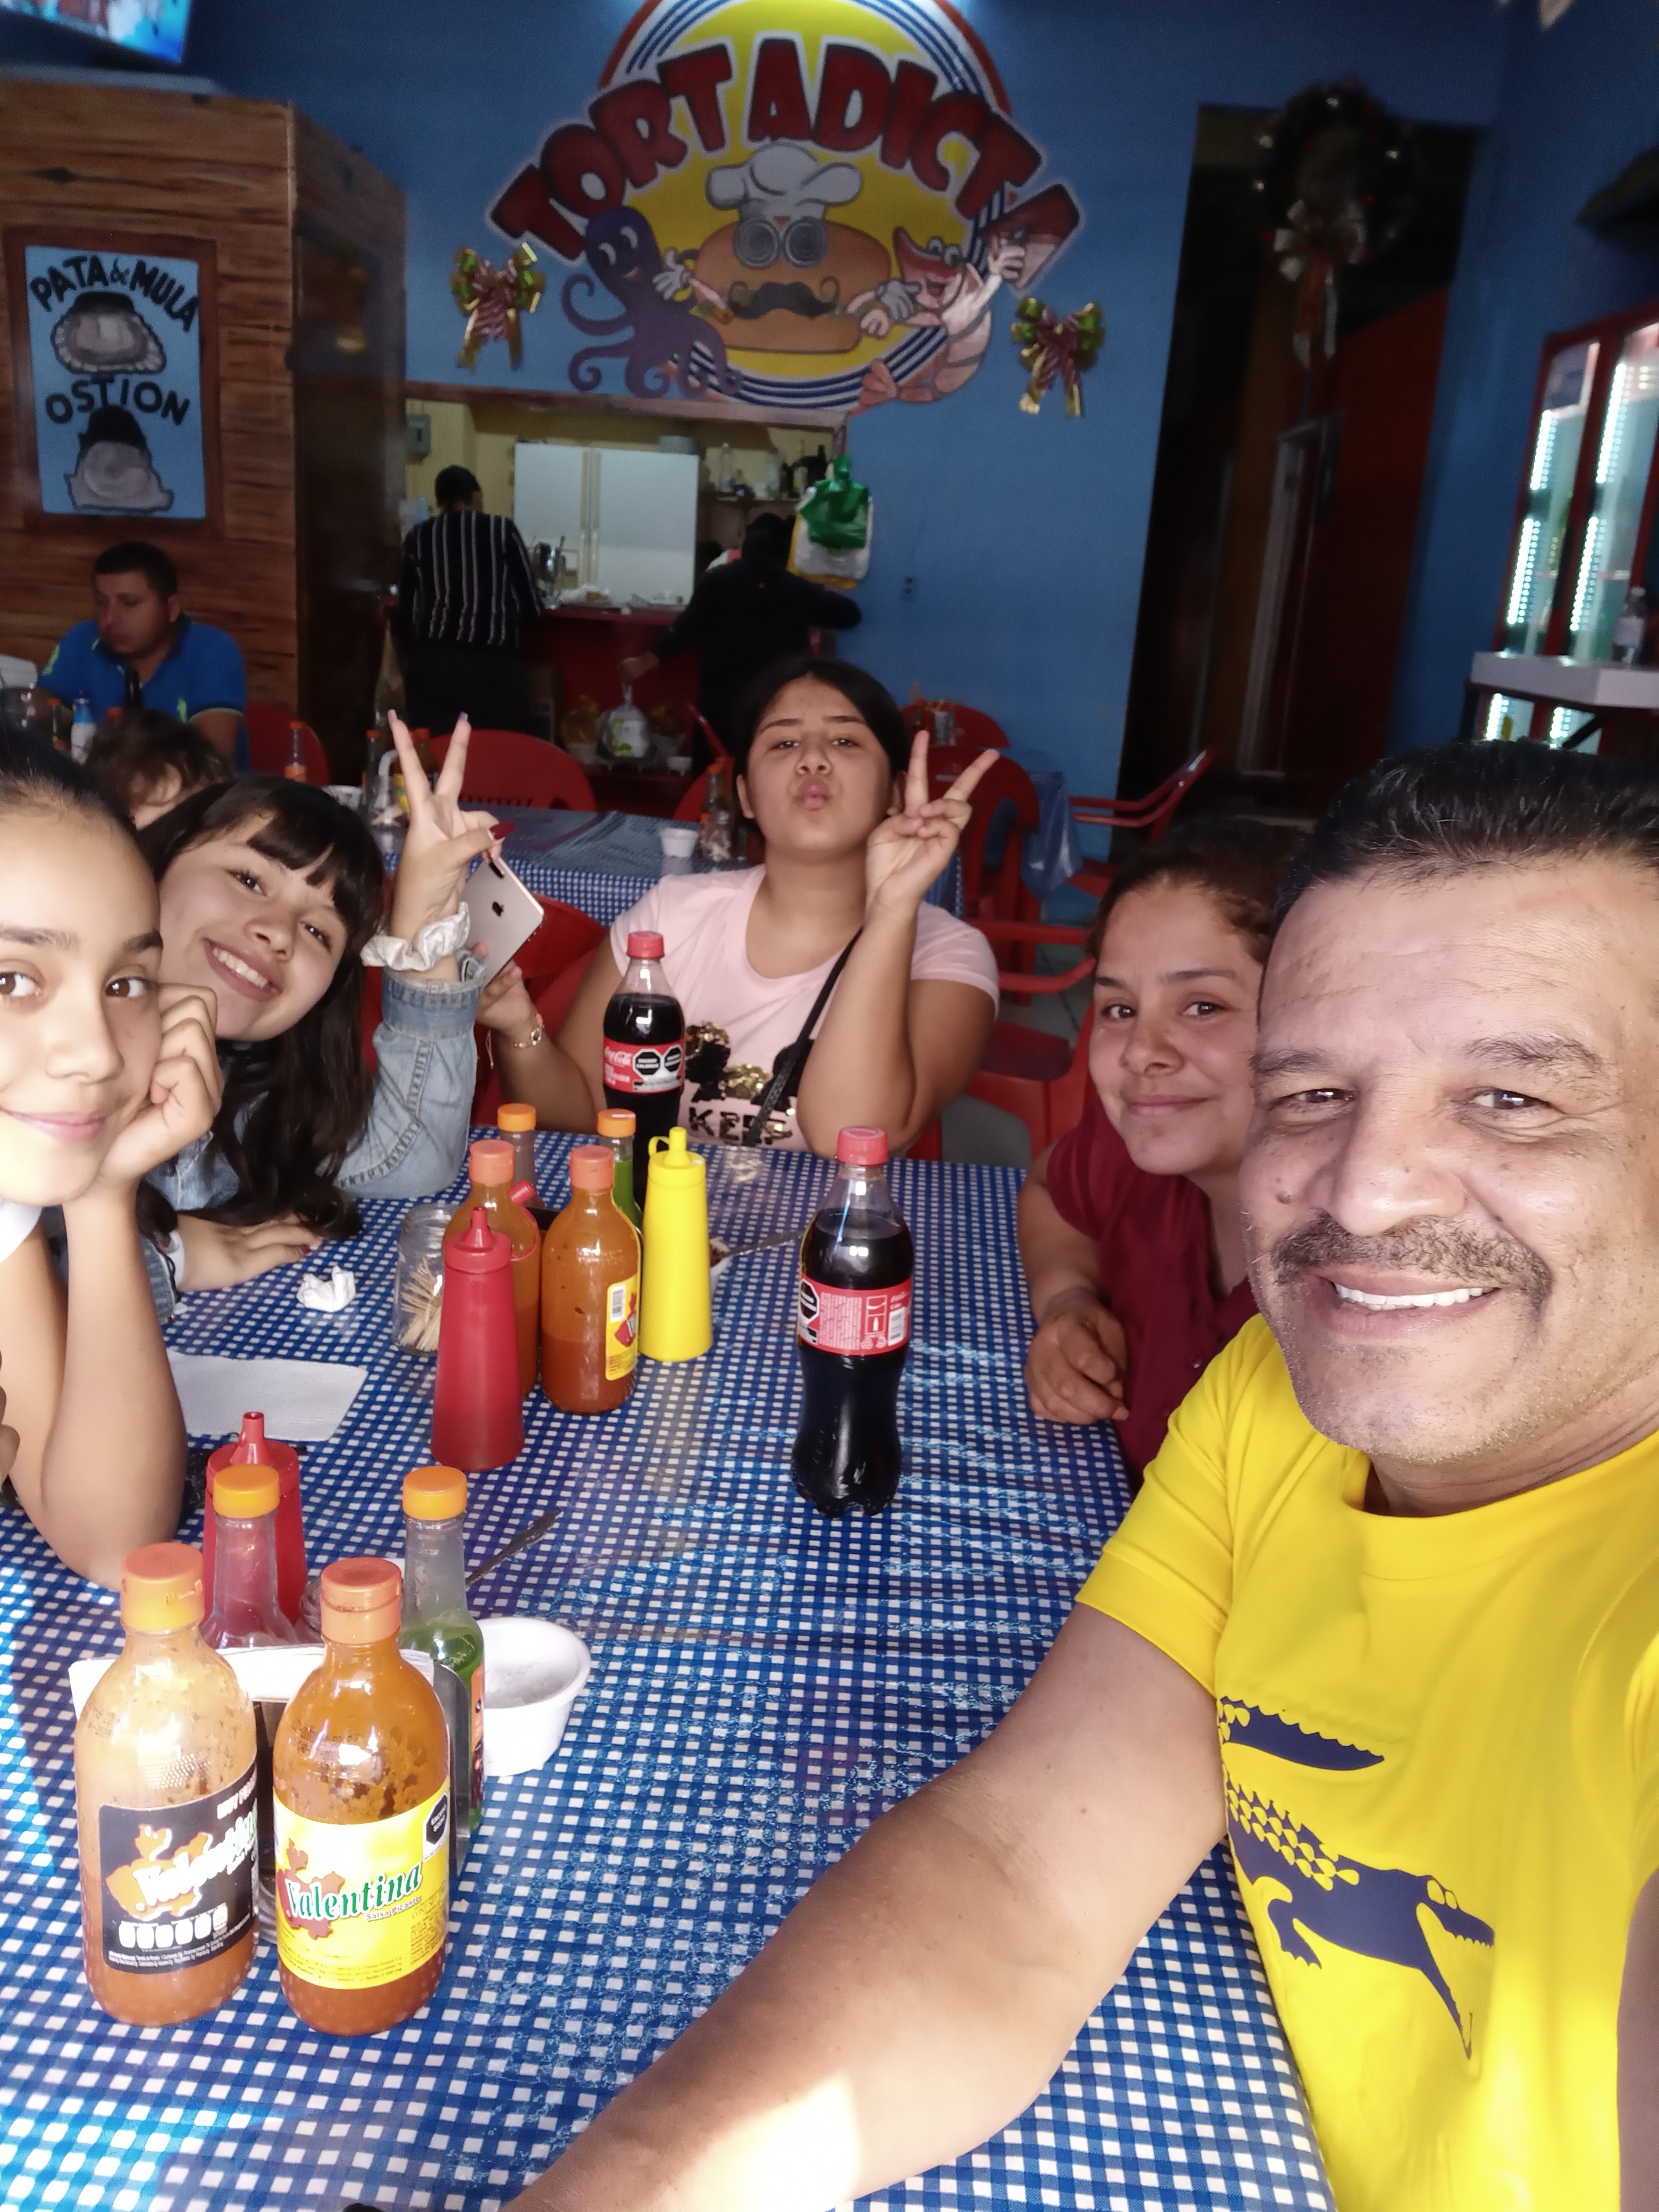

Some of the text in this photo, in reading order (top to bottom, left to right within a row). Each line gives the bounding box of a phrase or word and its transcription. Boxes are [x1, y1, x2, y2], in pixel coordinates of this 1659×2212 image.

[30, 255, 108, 312] PATA
[129, 259, 200, 333] MULA
[45, 378, 190, 426] OSTION
[287, 1864, 421, 1919] Valentina
[366, 1910, 389, 1921] Salsa
[391, 1896, 421, 1914] Picante
